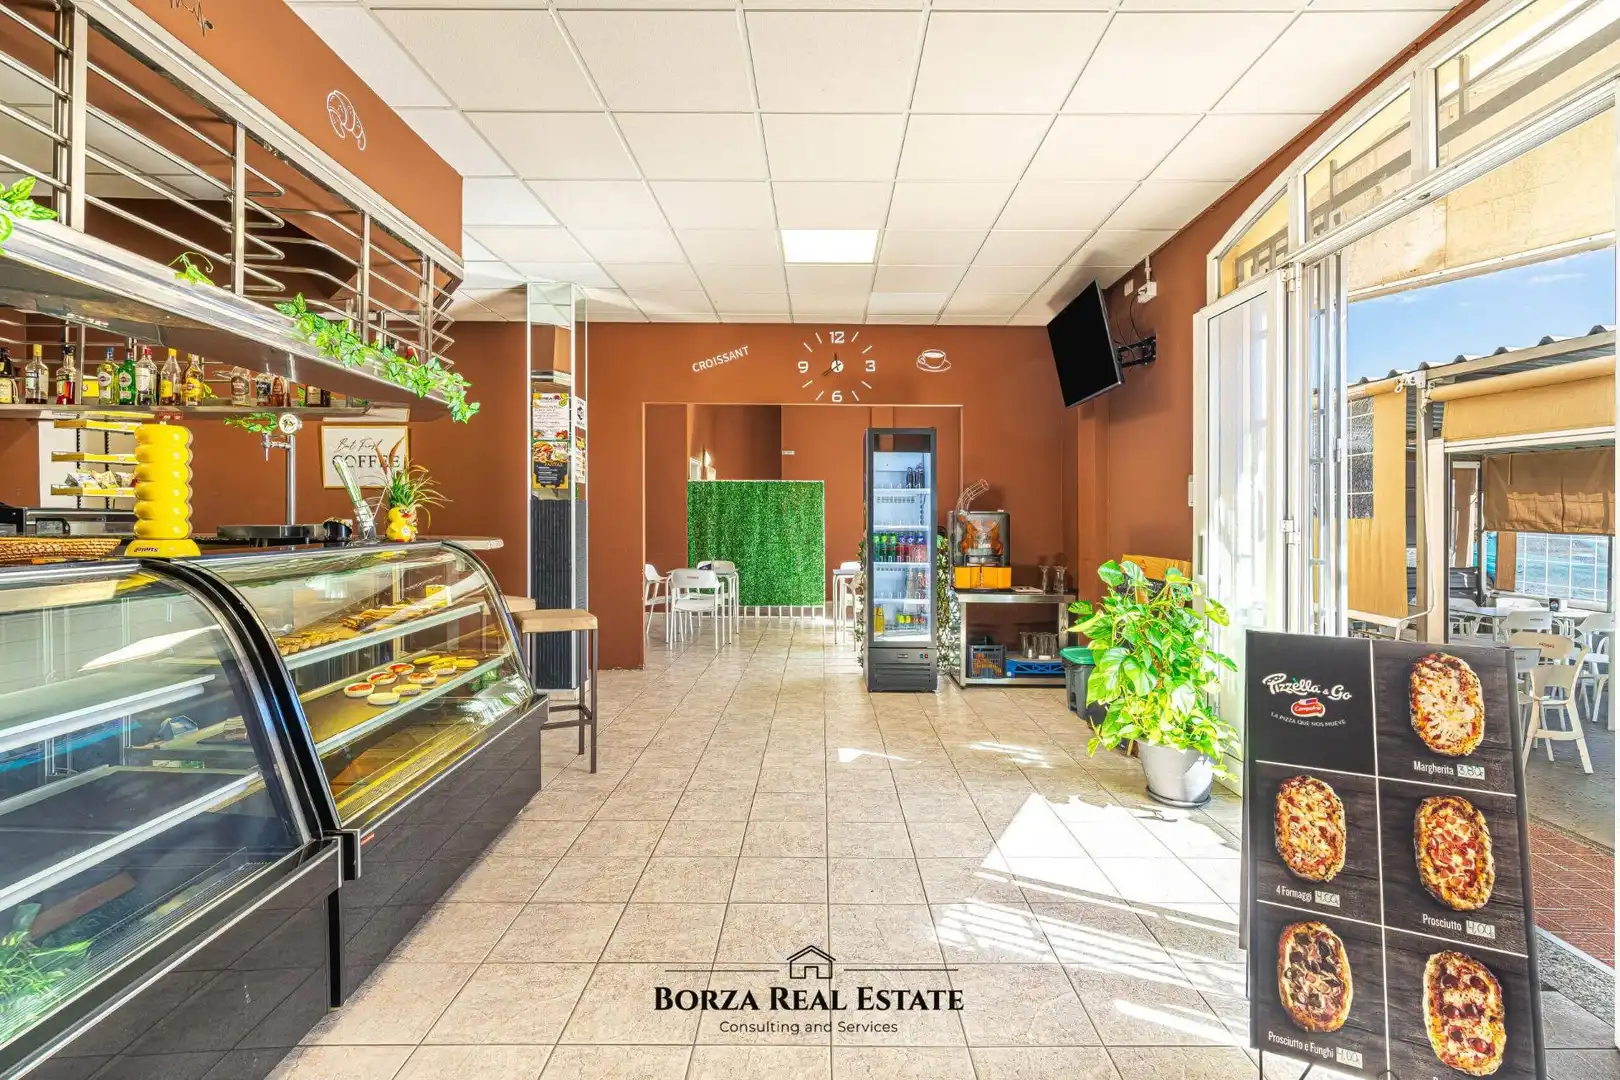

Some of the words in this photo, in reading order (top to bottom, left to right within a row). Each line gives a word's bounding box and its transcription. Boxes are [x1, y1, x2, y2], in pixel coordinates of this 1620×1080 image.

[829, 331, 845, 344] 12
[692, 345, 749, 372] CROISSANT
[865, 360, 876, 372] 3
[797, 361, 809, 373] 9
[831, 390, 843, 403] 6
[1328, 684, 1352, 700] Go
[1271, 711, 1279, 719] LA
[1280, 715, 1296, 724] PIZZA
[1297, 719, 1310, 727] QUE
[1325, 719, 1346, 727] MUEVE
[1413, 760, 1454, 775] Margherita
[1276, 884, 1281, 895] 4
[1282, 885, 1312, 902] Formaggi
[1422, 913, 1462, 931] Prosciutto
[1268, 1031, 1303, 1049] Prosciutto
[1304, 1043, 1309, 1051] e
[1310, 1042, 1334, 1059] Funghi
